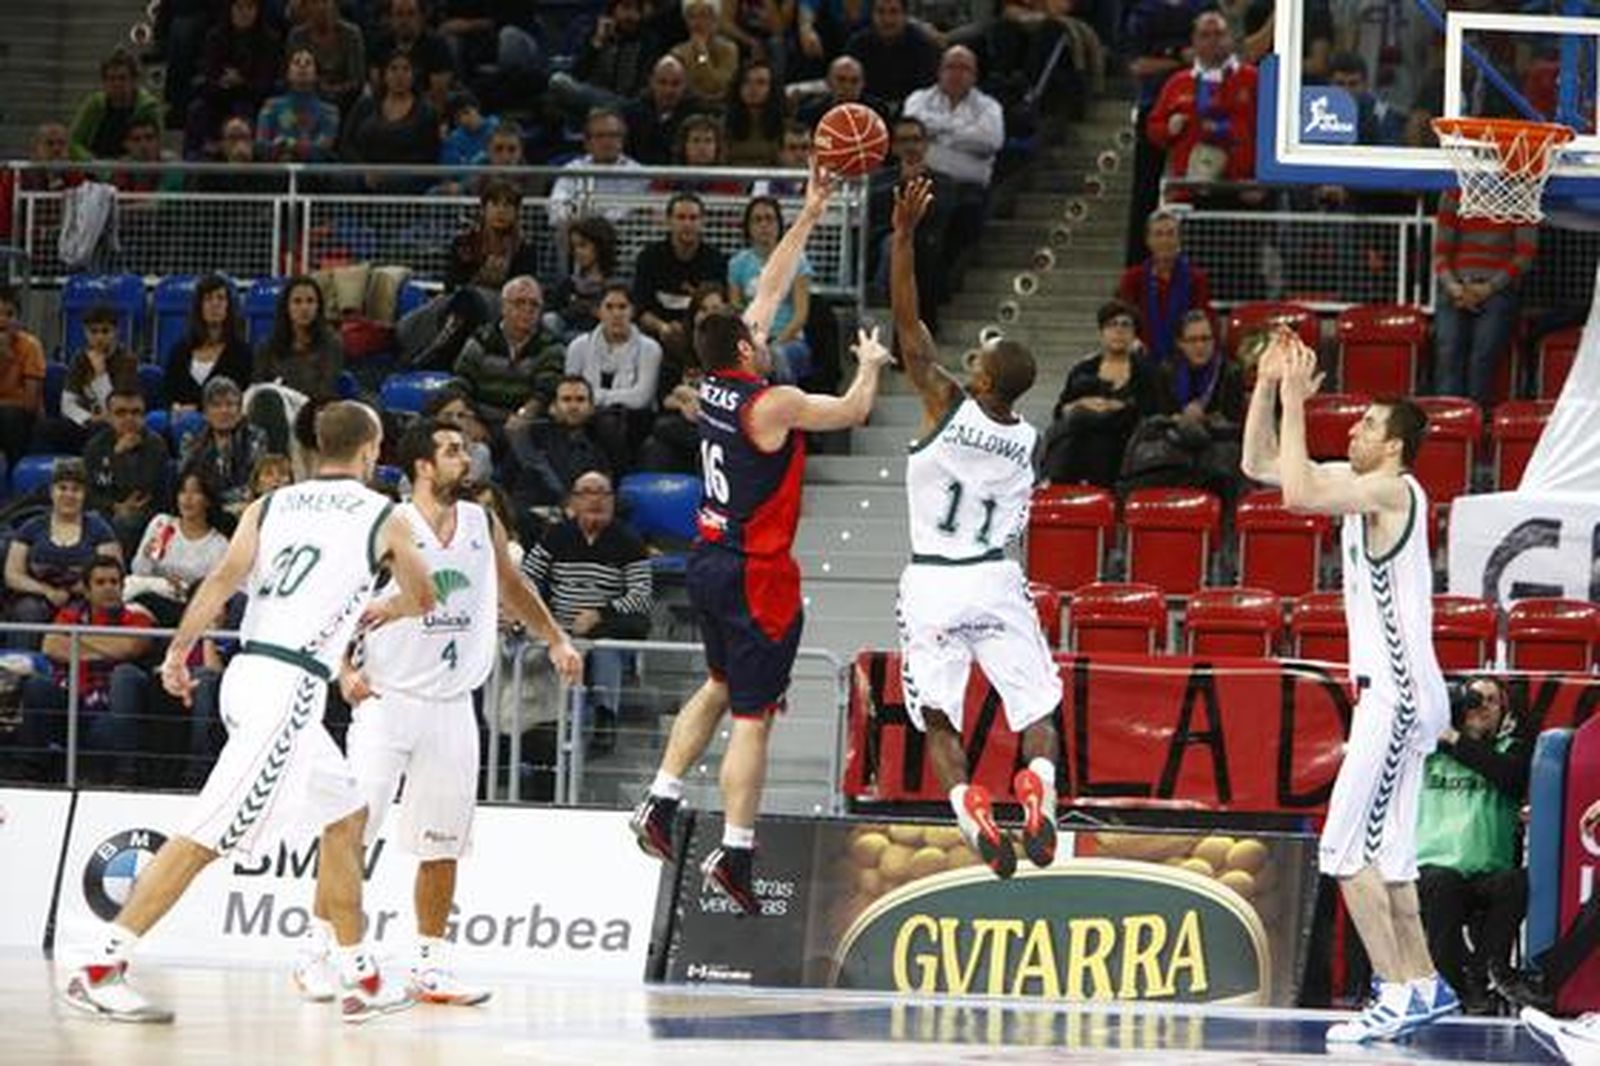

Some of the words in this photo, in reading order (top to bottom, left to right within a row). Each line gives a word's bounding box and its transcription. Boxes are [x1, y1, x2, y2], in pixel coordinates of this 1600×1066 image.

[701, 438, 730, 504] 16
[938, 480, 998, 546] 11
[258, 544, 321, 597] 20
[441, 639, 458, 670] 4
